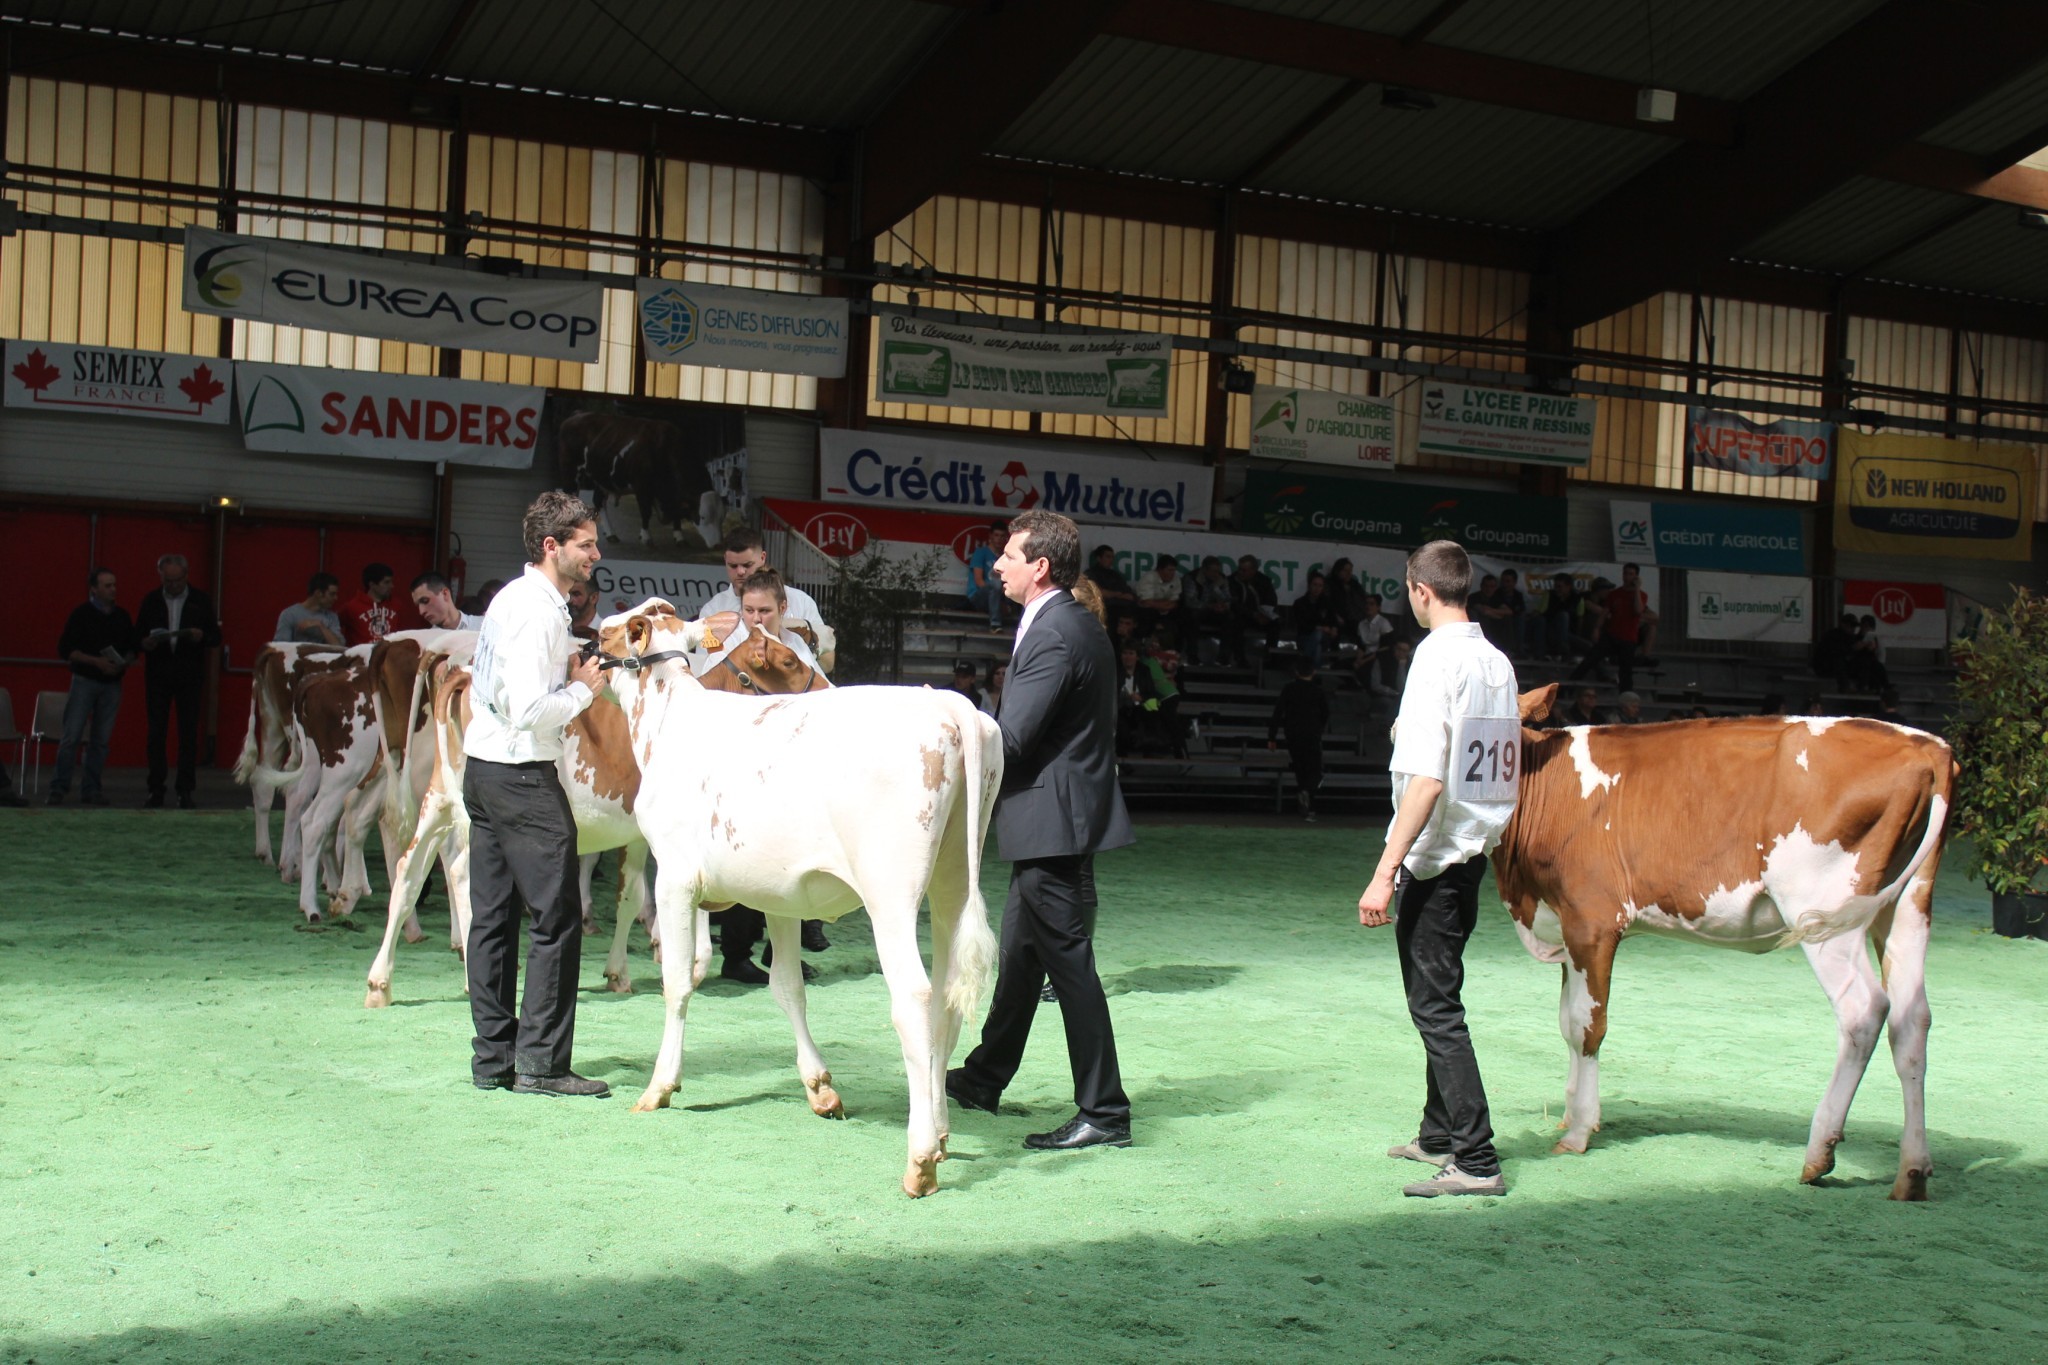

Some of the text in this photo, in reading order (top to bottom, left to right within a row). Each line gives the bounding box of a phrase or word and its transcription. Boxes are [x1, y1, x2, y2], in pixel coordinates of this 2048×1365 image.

[704, 307, 840, 338] GENES DIFFUSION
[891, 316, 917, 333] Des
[984, 338, 1009, 350] une
[703, 333, 726, 346] Nous
[772, 342, 793, 352] vous
[73, 350, 165, 389] SEMEX
[74, 386, 165, 404] FRANCE
[1463, 388, 1579, 418] LYCEE PRIVE
[321, 391, 537, 450] SANDERS
[1337, 400, 1391, 421] CHAMBRE
[1445, 408, 1459, 421] E.
[1462, 410, 1528, 430] GAUTIER
[1533, 418, 1591, 436] RESSINS
[1306, 418, 1391, 441] D'AGRICULTURE
[1358, 444, 1391, 462] LOIRE
[847, 448, 1185, 522] Crédit Mutuel
[1891, 479, 2007, 504] NEW HOLLAND
[1311, 511, 1403, 536] Groupama
[1889, 512, 1979, 532] AGRICULTURE
[818, 519, 858, 551] LELY
[1464, 523, 1550, 547] Groupama
[1659, 530, 1799, 551] CRÉDIT AGRICOLE
[1723, 600, 1783, 616] supranimal
[1880, 594, 1907, 619] LELY
[1465, 739, 1516, 783] 219
